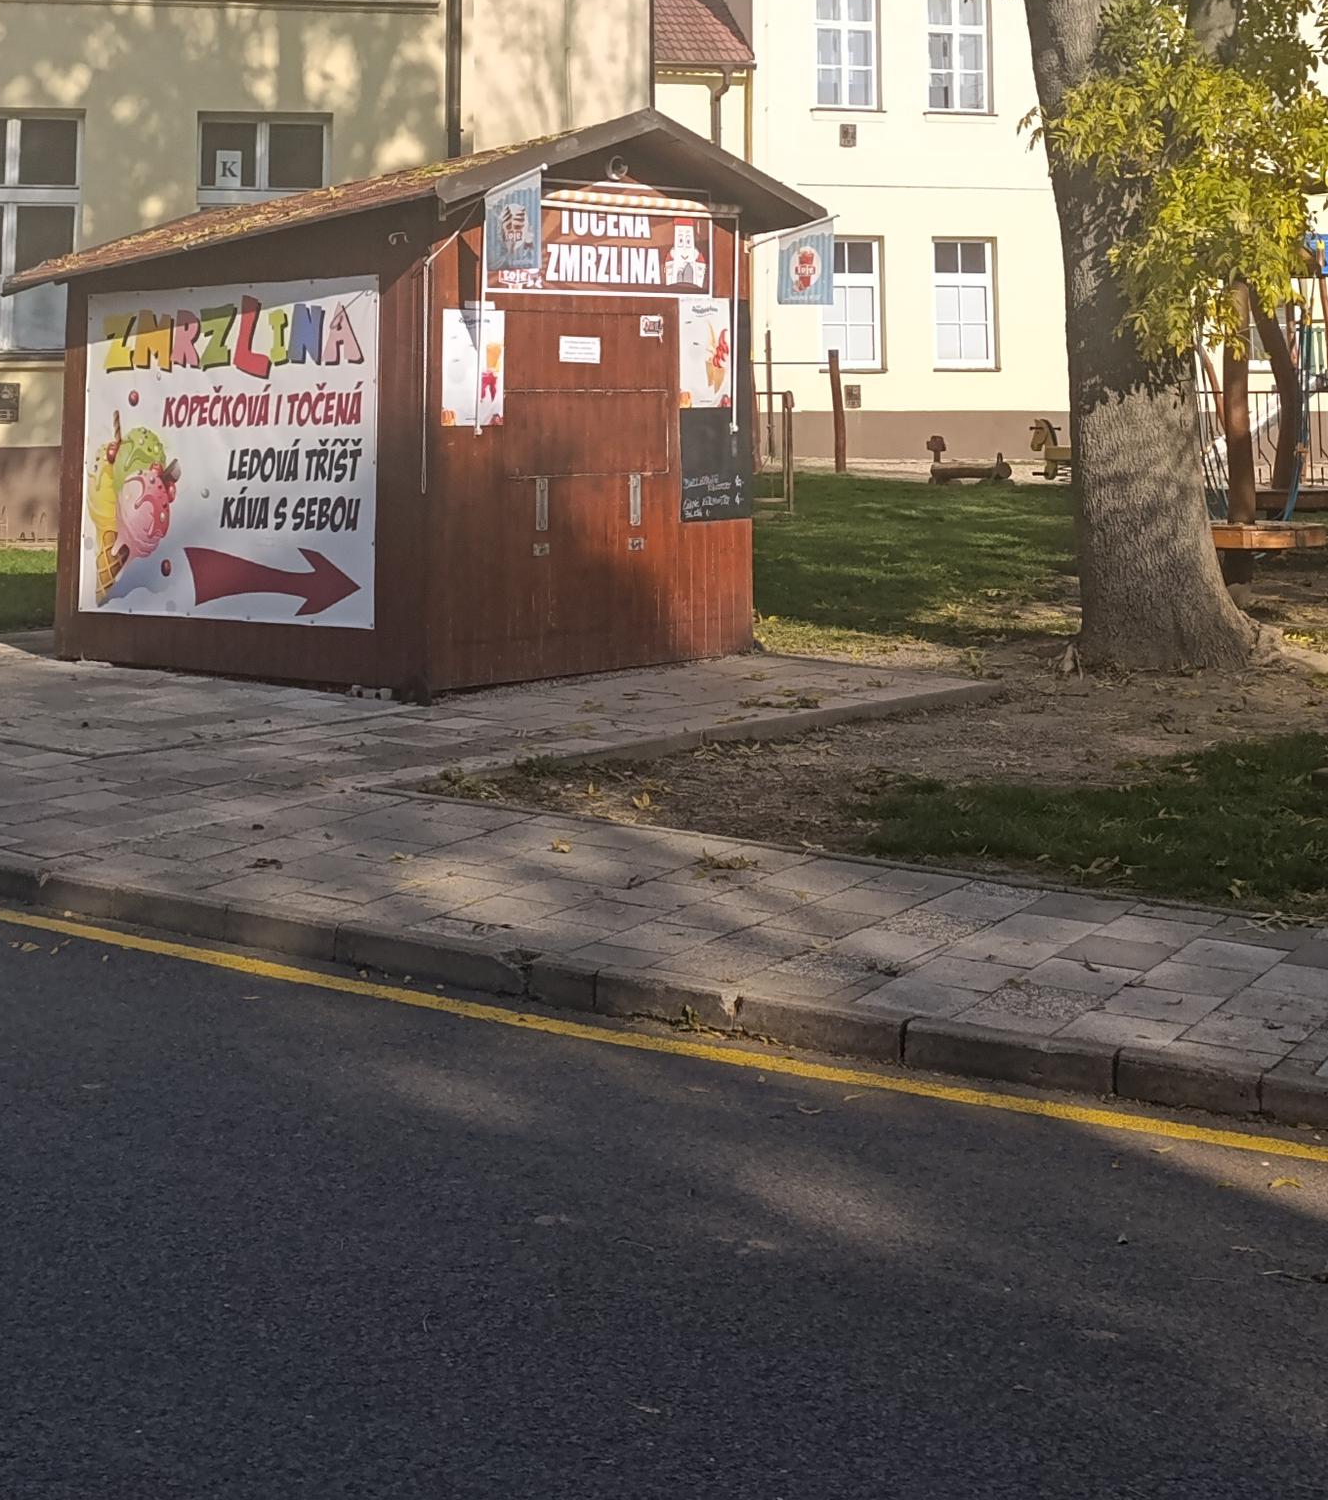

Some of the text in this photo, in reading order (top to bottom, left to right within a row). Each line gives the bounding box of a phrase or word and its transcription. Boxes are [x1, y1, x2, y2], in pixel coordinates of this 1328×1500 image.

[220, 161, 238, 177] K
[545, 243, 661, 285] ZMRZLINA
[103, 295, 364, 379] ZMRZLINA
[162, 381, 363, 428] KOPEČKOVÁ I TOČENÁ
[227, 438, 362, 483] LEDOVÁ TŘÍŠŤ
[220, 486, 361, 532] KÁVA S SEBOU
